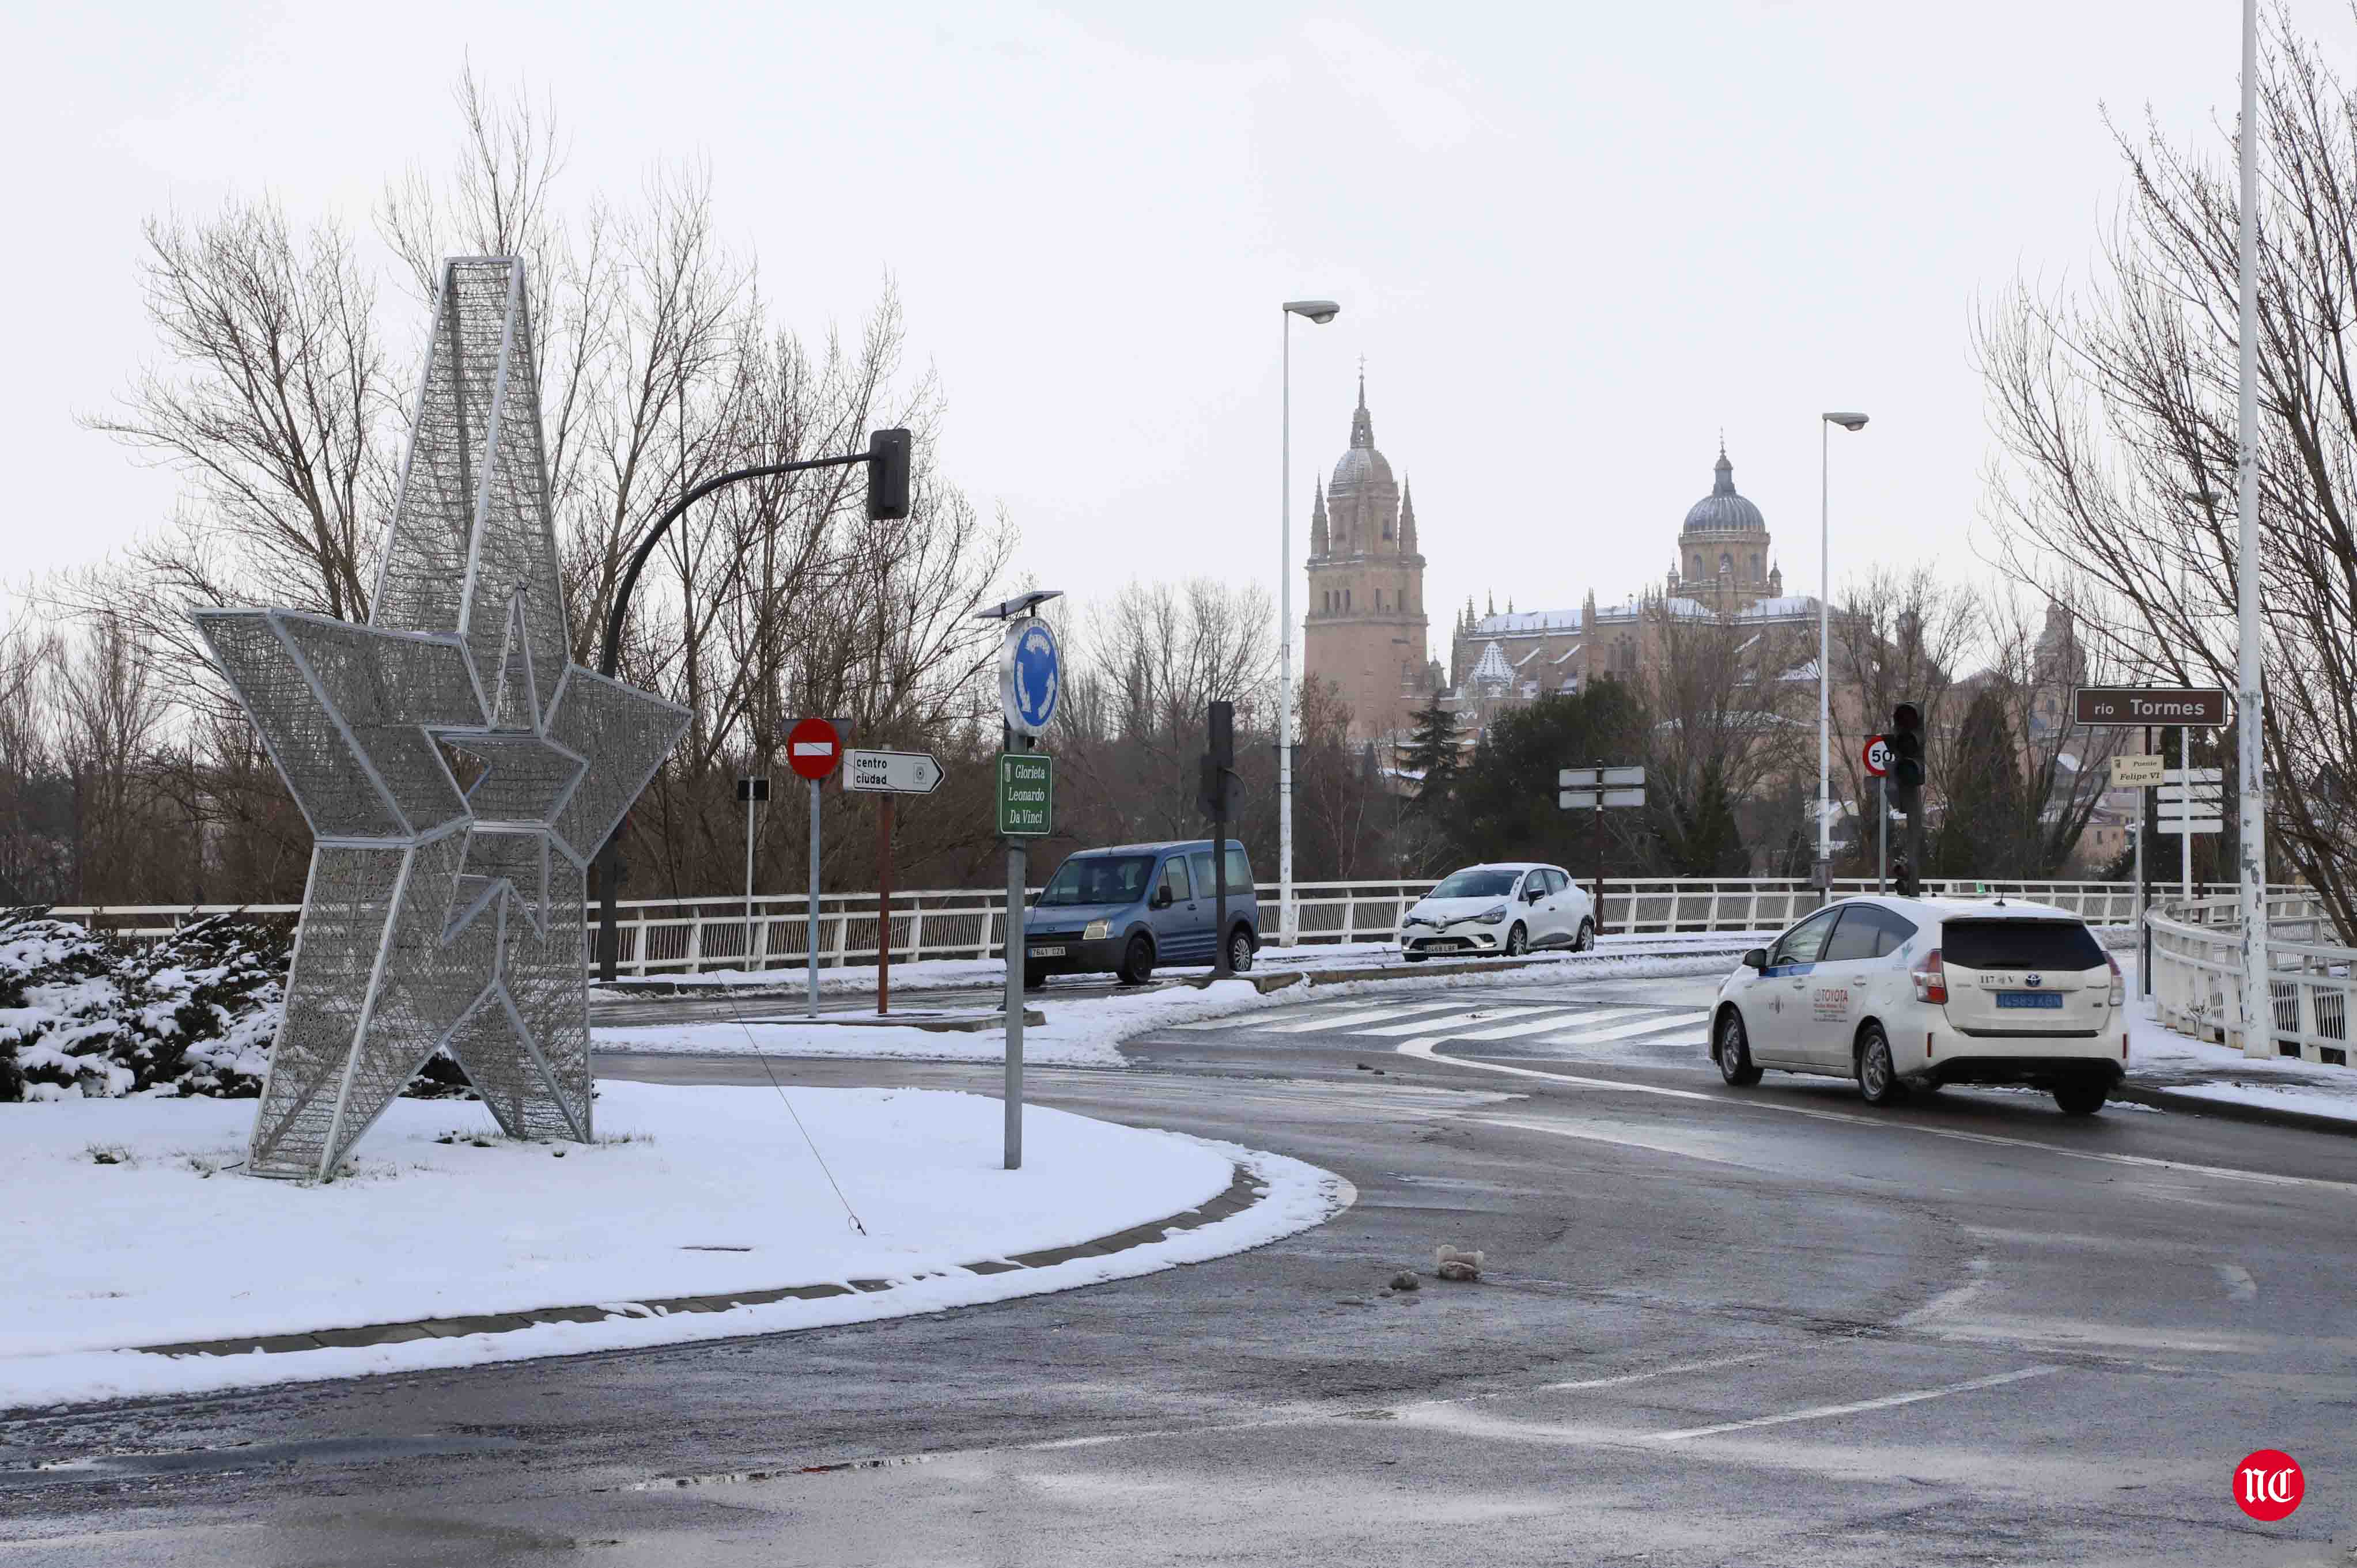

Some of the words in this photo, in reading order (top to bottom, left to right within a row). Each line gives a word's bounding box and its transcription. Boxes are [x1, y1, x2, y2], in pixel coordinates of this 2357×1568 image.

[2130, 699, 2205, 715] Tormes
[1872, 749, 1893, 762] 50
[856, 758, 887, 769] centro
[1015, 764, 1046, 779] Glorieta
[2120, 772, 2148, 781] Felipe
[2149, 771, 2161, 779] VI
[856, 773, 887, 785] ciudad
[1008, 786, 1045, 802] Leonardo
[1009, 809, 1020, 824] Da
[1023, 809, 1043, 824] Vinci
[1821, 988, 1848, 1002] TOYOTA
